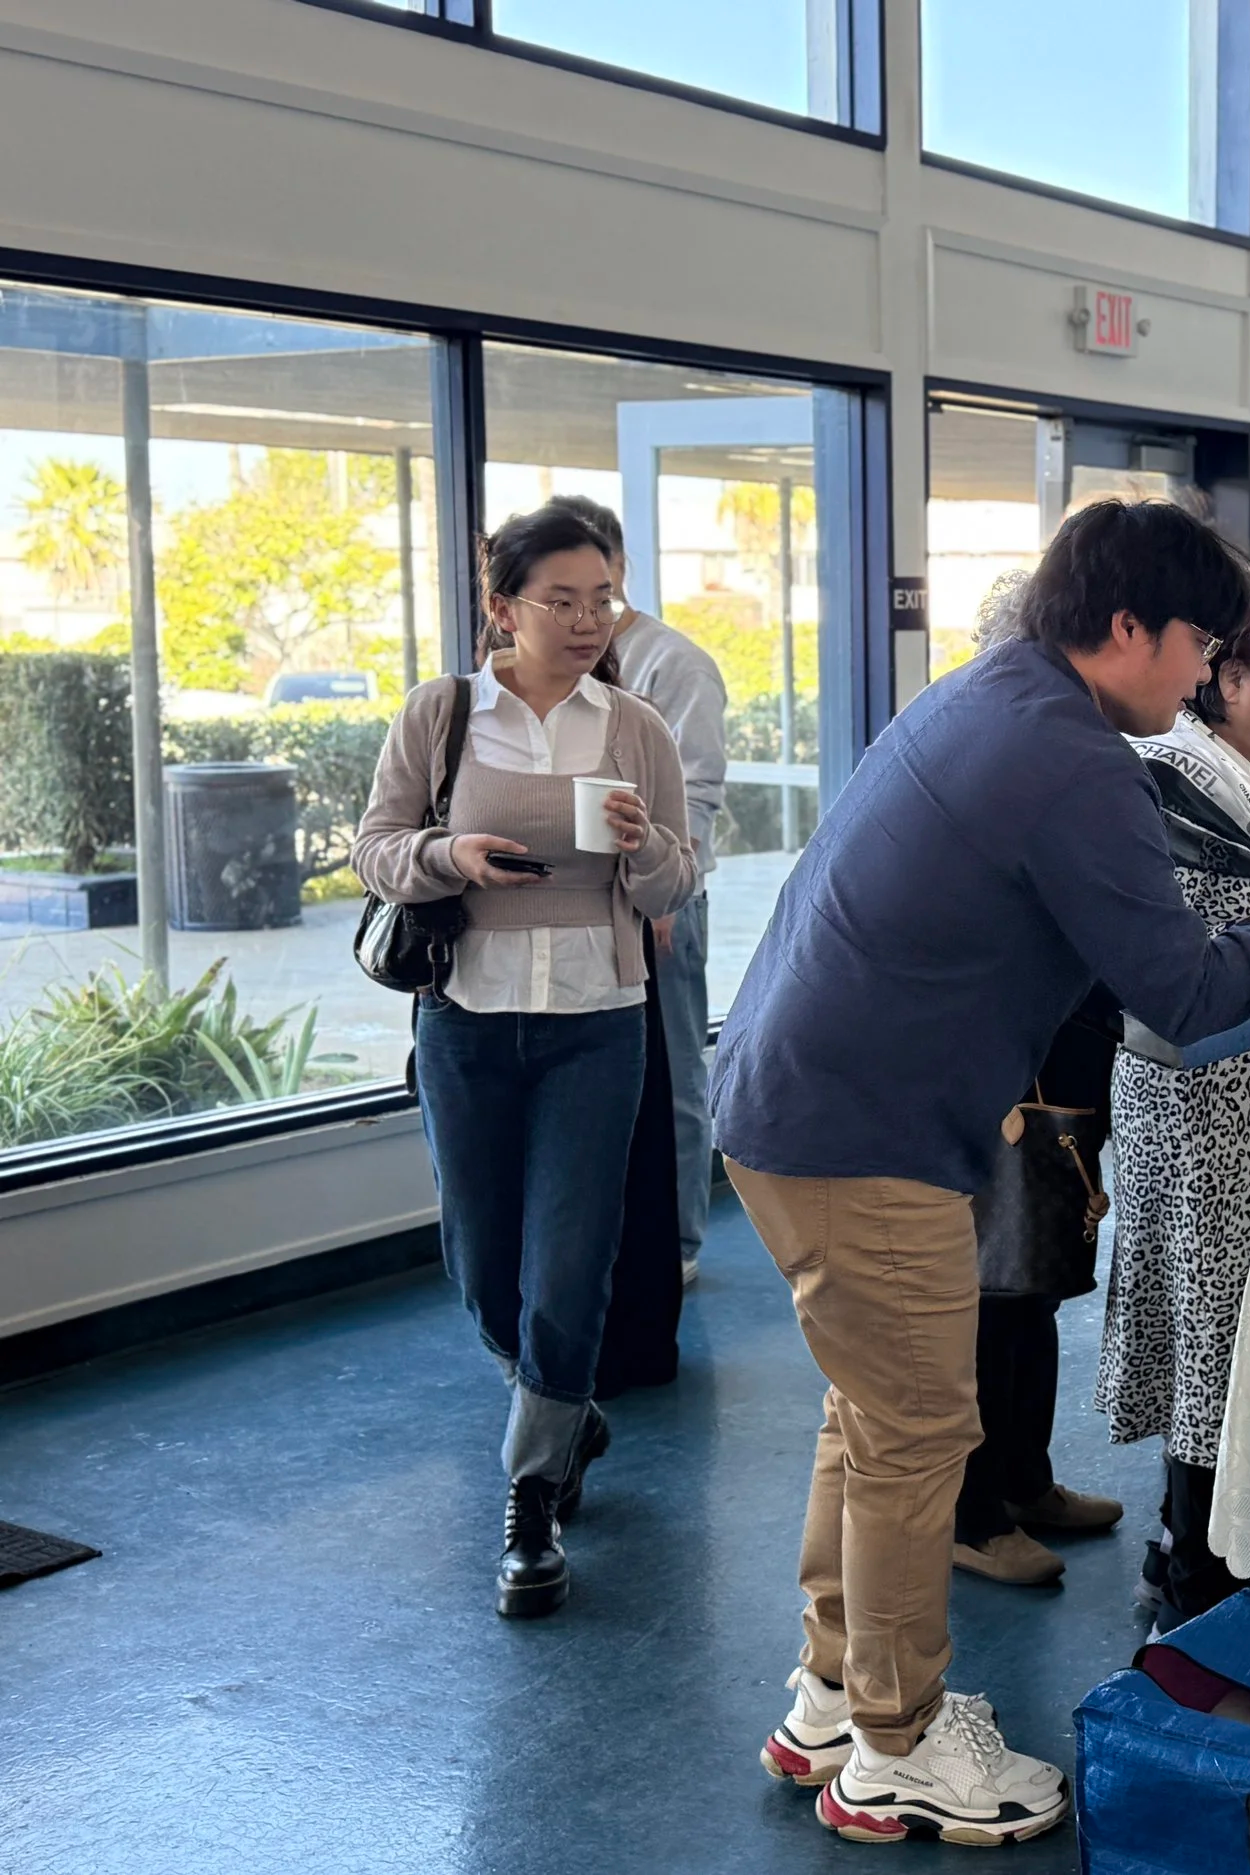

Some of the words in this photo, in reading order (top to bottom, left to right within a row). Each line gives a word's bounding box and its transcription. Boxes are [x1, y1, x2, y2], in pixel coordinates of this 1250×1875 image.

[1095, 291, 1132, 348] EXIT
[894, 589, 928, 610] EXIT
[1134, 744, 1218, 797] CHANEL
[893, 1770, 934, 1788] BALENCIAGA
